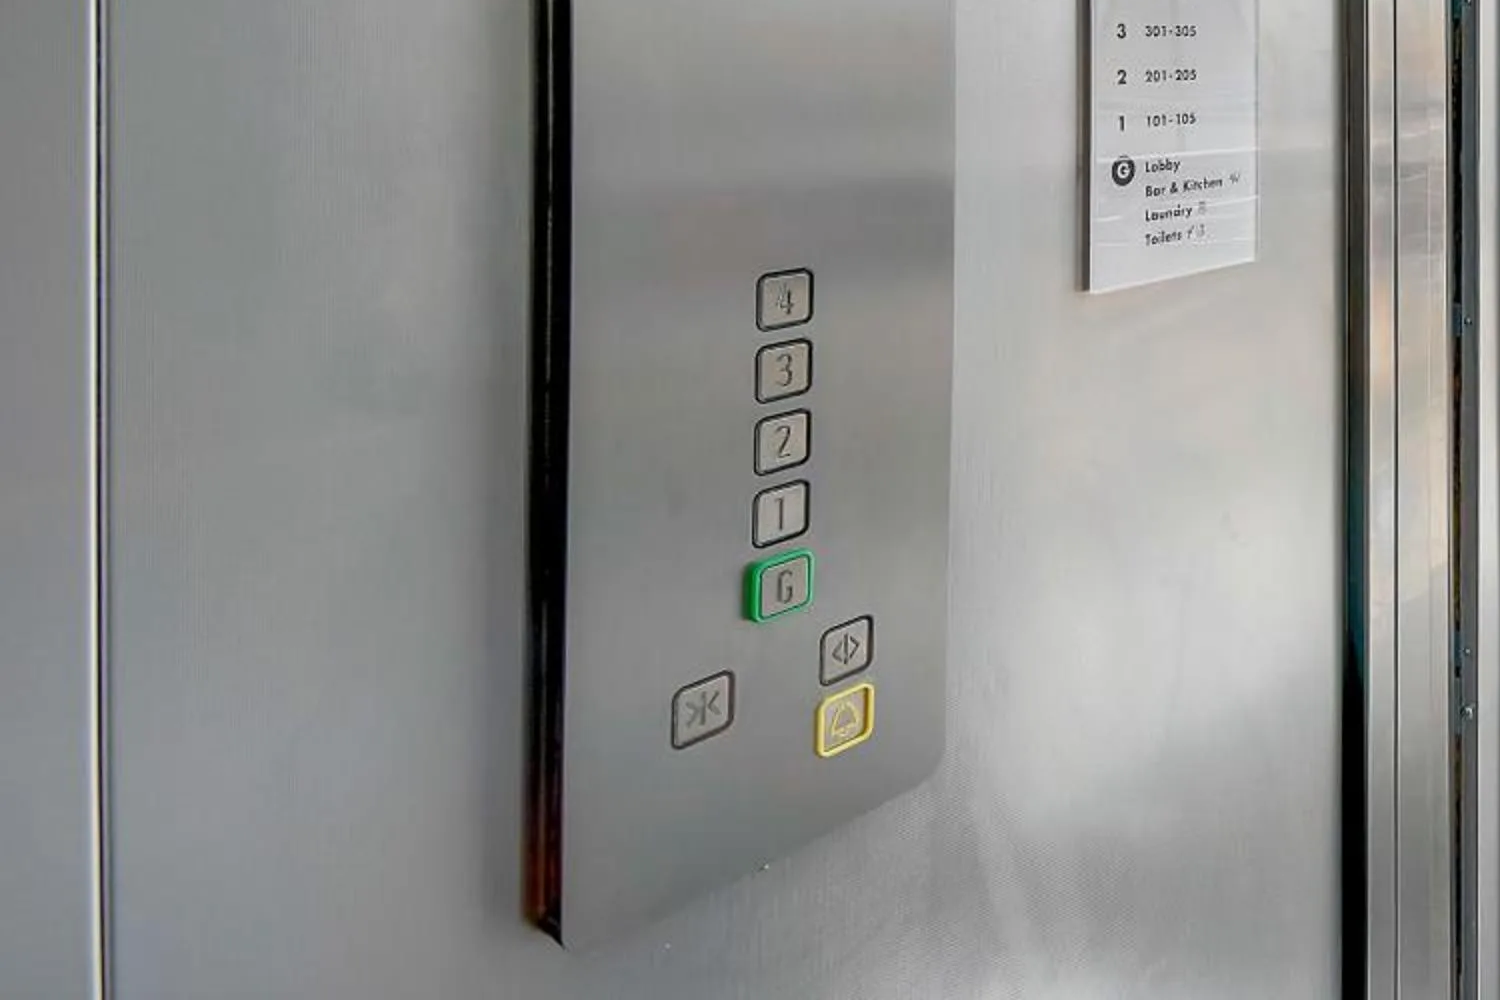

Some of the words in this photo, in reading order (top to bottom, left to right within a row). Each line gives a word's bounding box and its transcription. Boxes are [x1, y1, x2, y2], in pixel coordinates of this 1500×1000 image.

[1116, 23, 1127, 39] 3
[1117, 69, 1127, 85] 2
[1119, 115, 1125, 132] 1
[1145, 159, 1181, 173] Lobby
[1145, 185, 1166, 197] Bar
[1170, 182, 1179, 193] &
[1183, 177, 1223, 192] Kitchen
[1145, 204, 1193, 222] Laundry
[1145, 231, 1182, 247] Toilets
[776, 282, 795, 316] 4
[775, 352, 794, 388] 3
[774, 425, 791, 459] 2
[773, 496, 786, 531] 1
[776, 570, 794, 605] G
